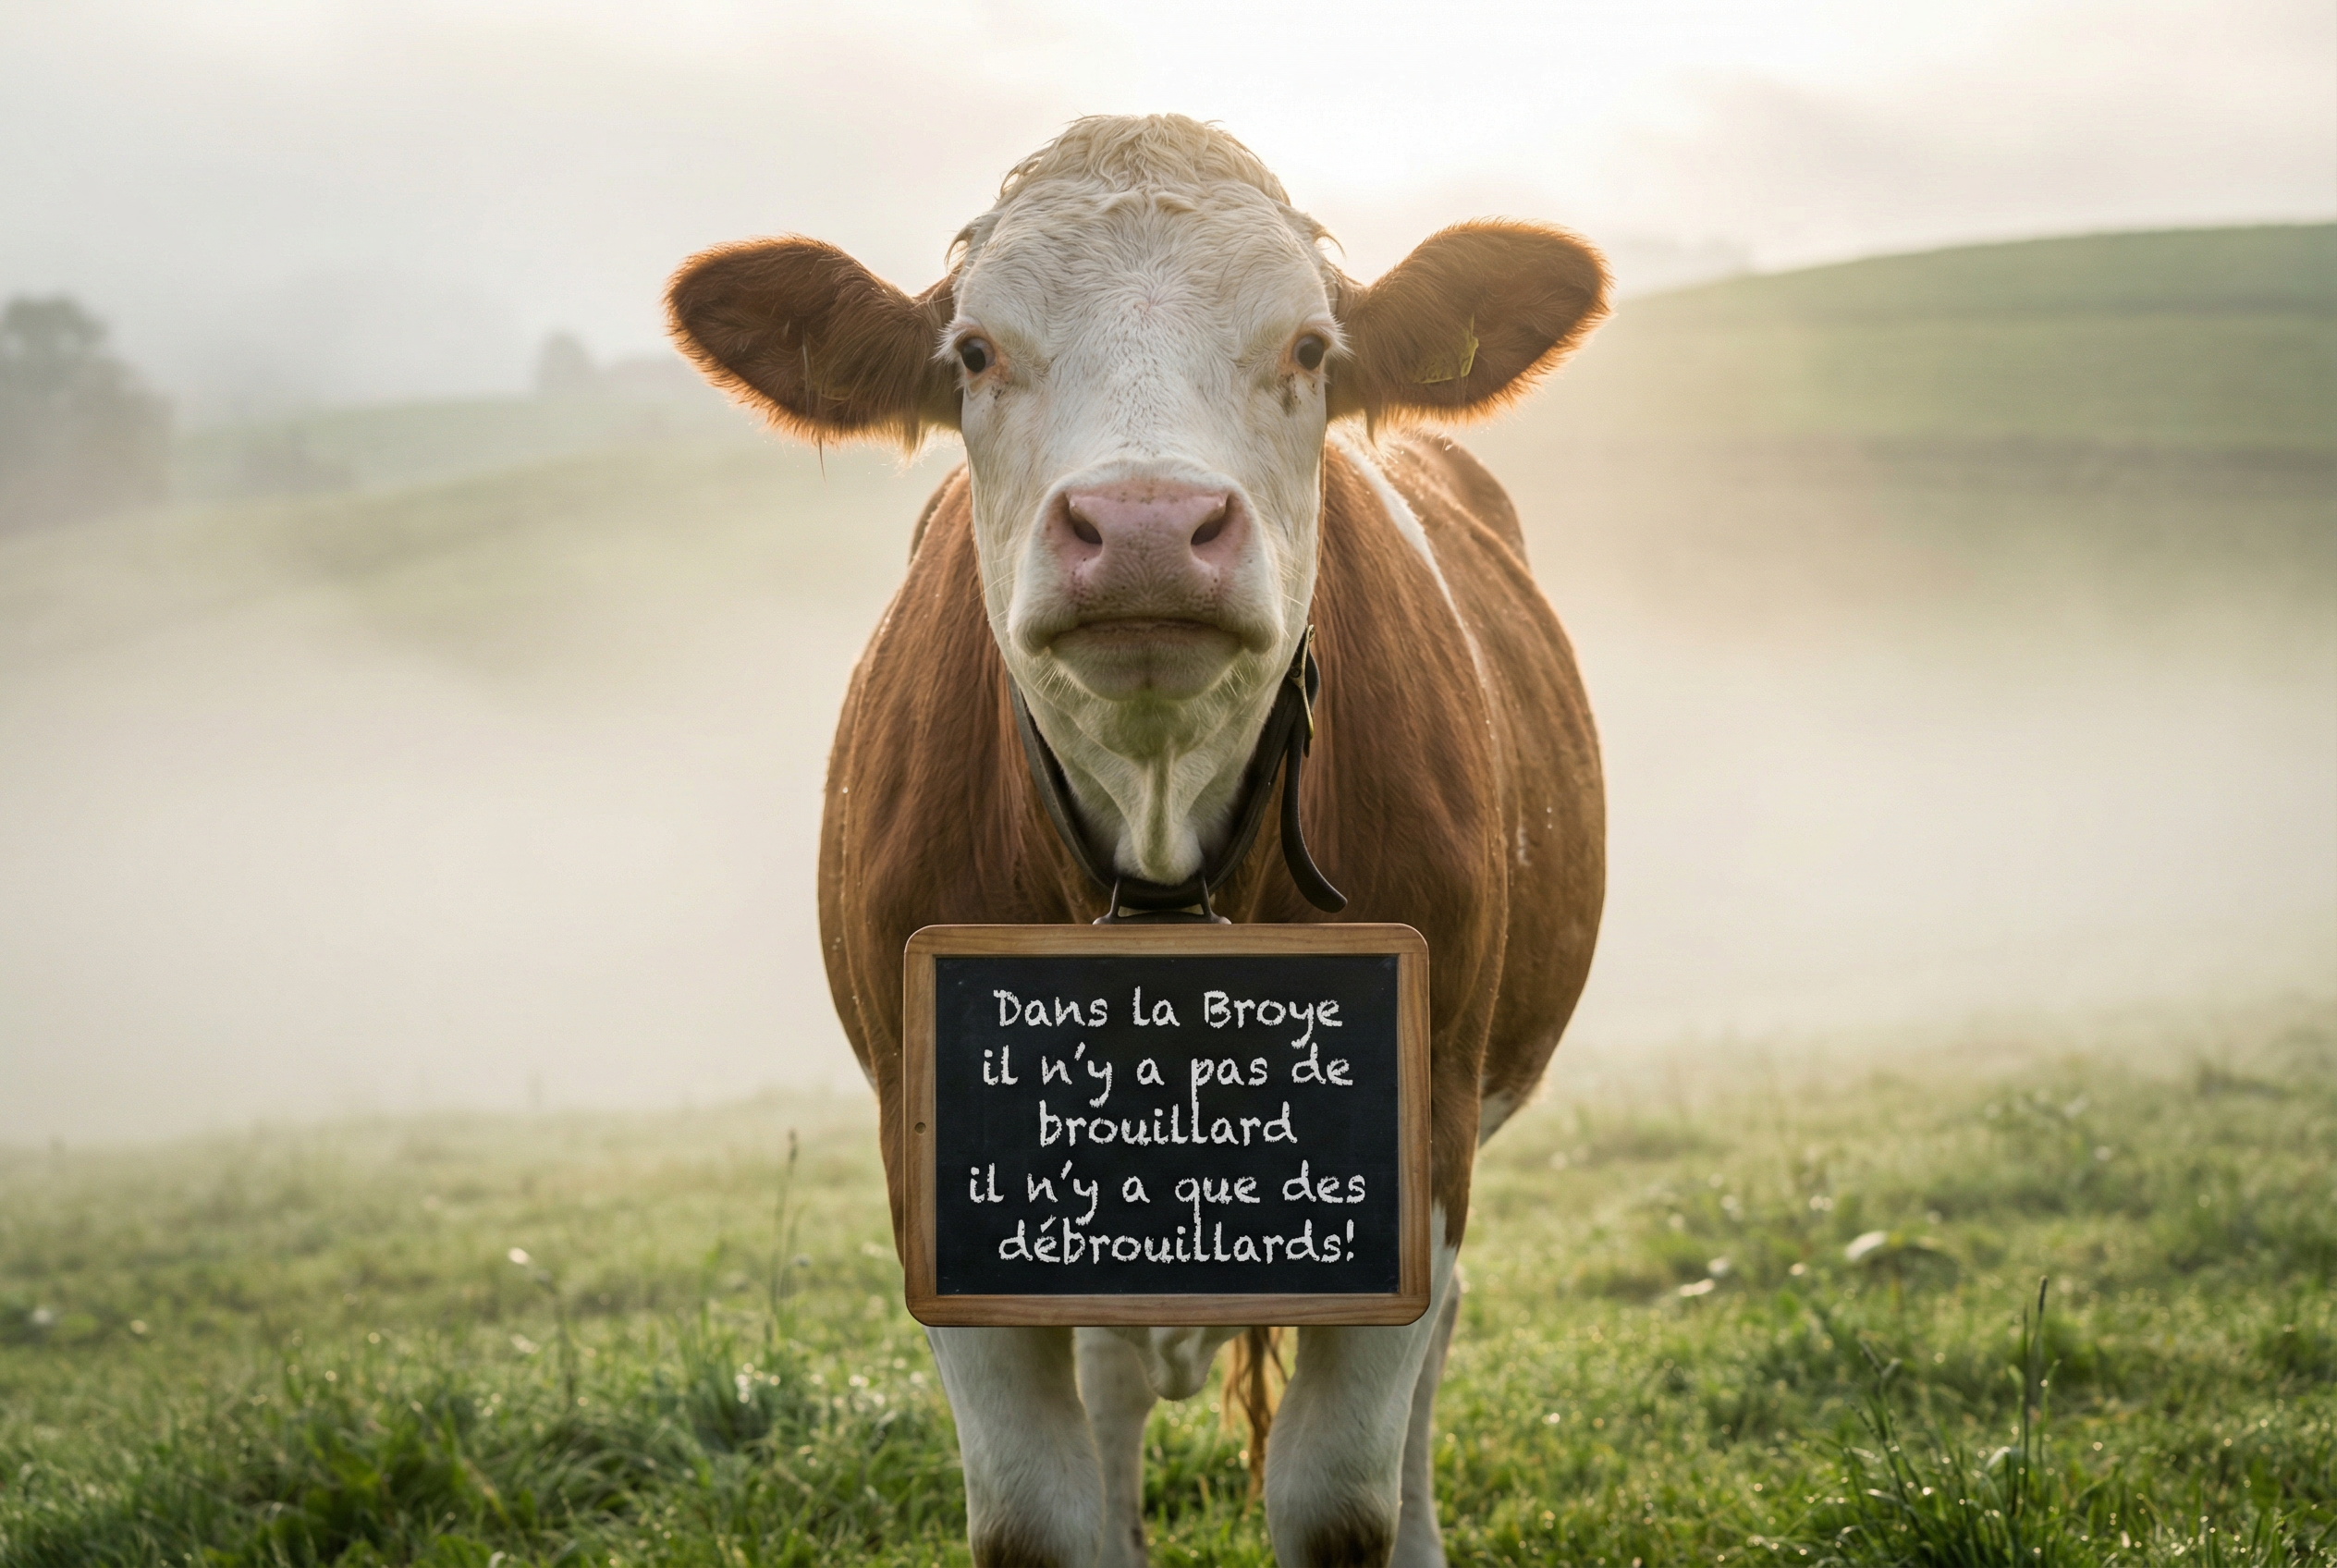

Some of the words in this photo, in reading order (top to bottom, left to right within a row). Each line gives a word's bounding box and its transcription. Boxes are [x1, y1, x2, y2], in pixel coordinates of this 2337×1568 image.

[994, 989, 1107, 1027] Dans
[1133, 986, 1180, 1026] la
[1204, 990, 1343, 1048] Broye
[984, 1045, 1018, 1085] il
[1041, 1042, 1113, 1108] n'y
[1137, 1058, 1165, 1085] a
[1191, 1058, 1267, 1108] pas
[1292, 1043, 1353, 1085] de
[1039, 1100, 1298, 1147] brouillard
[970, 1163, 1004, 1203] il
[1026, 1160, 1098, 1226] n'y
[1121, 1176, 1151, 1203] a
[1175, 1176, 1261, 1225] que
[1282, 1160, 1365, 1203] des
[998, 1215, 1354, 1265] débrouillards!
